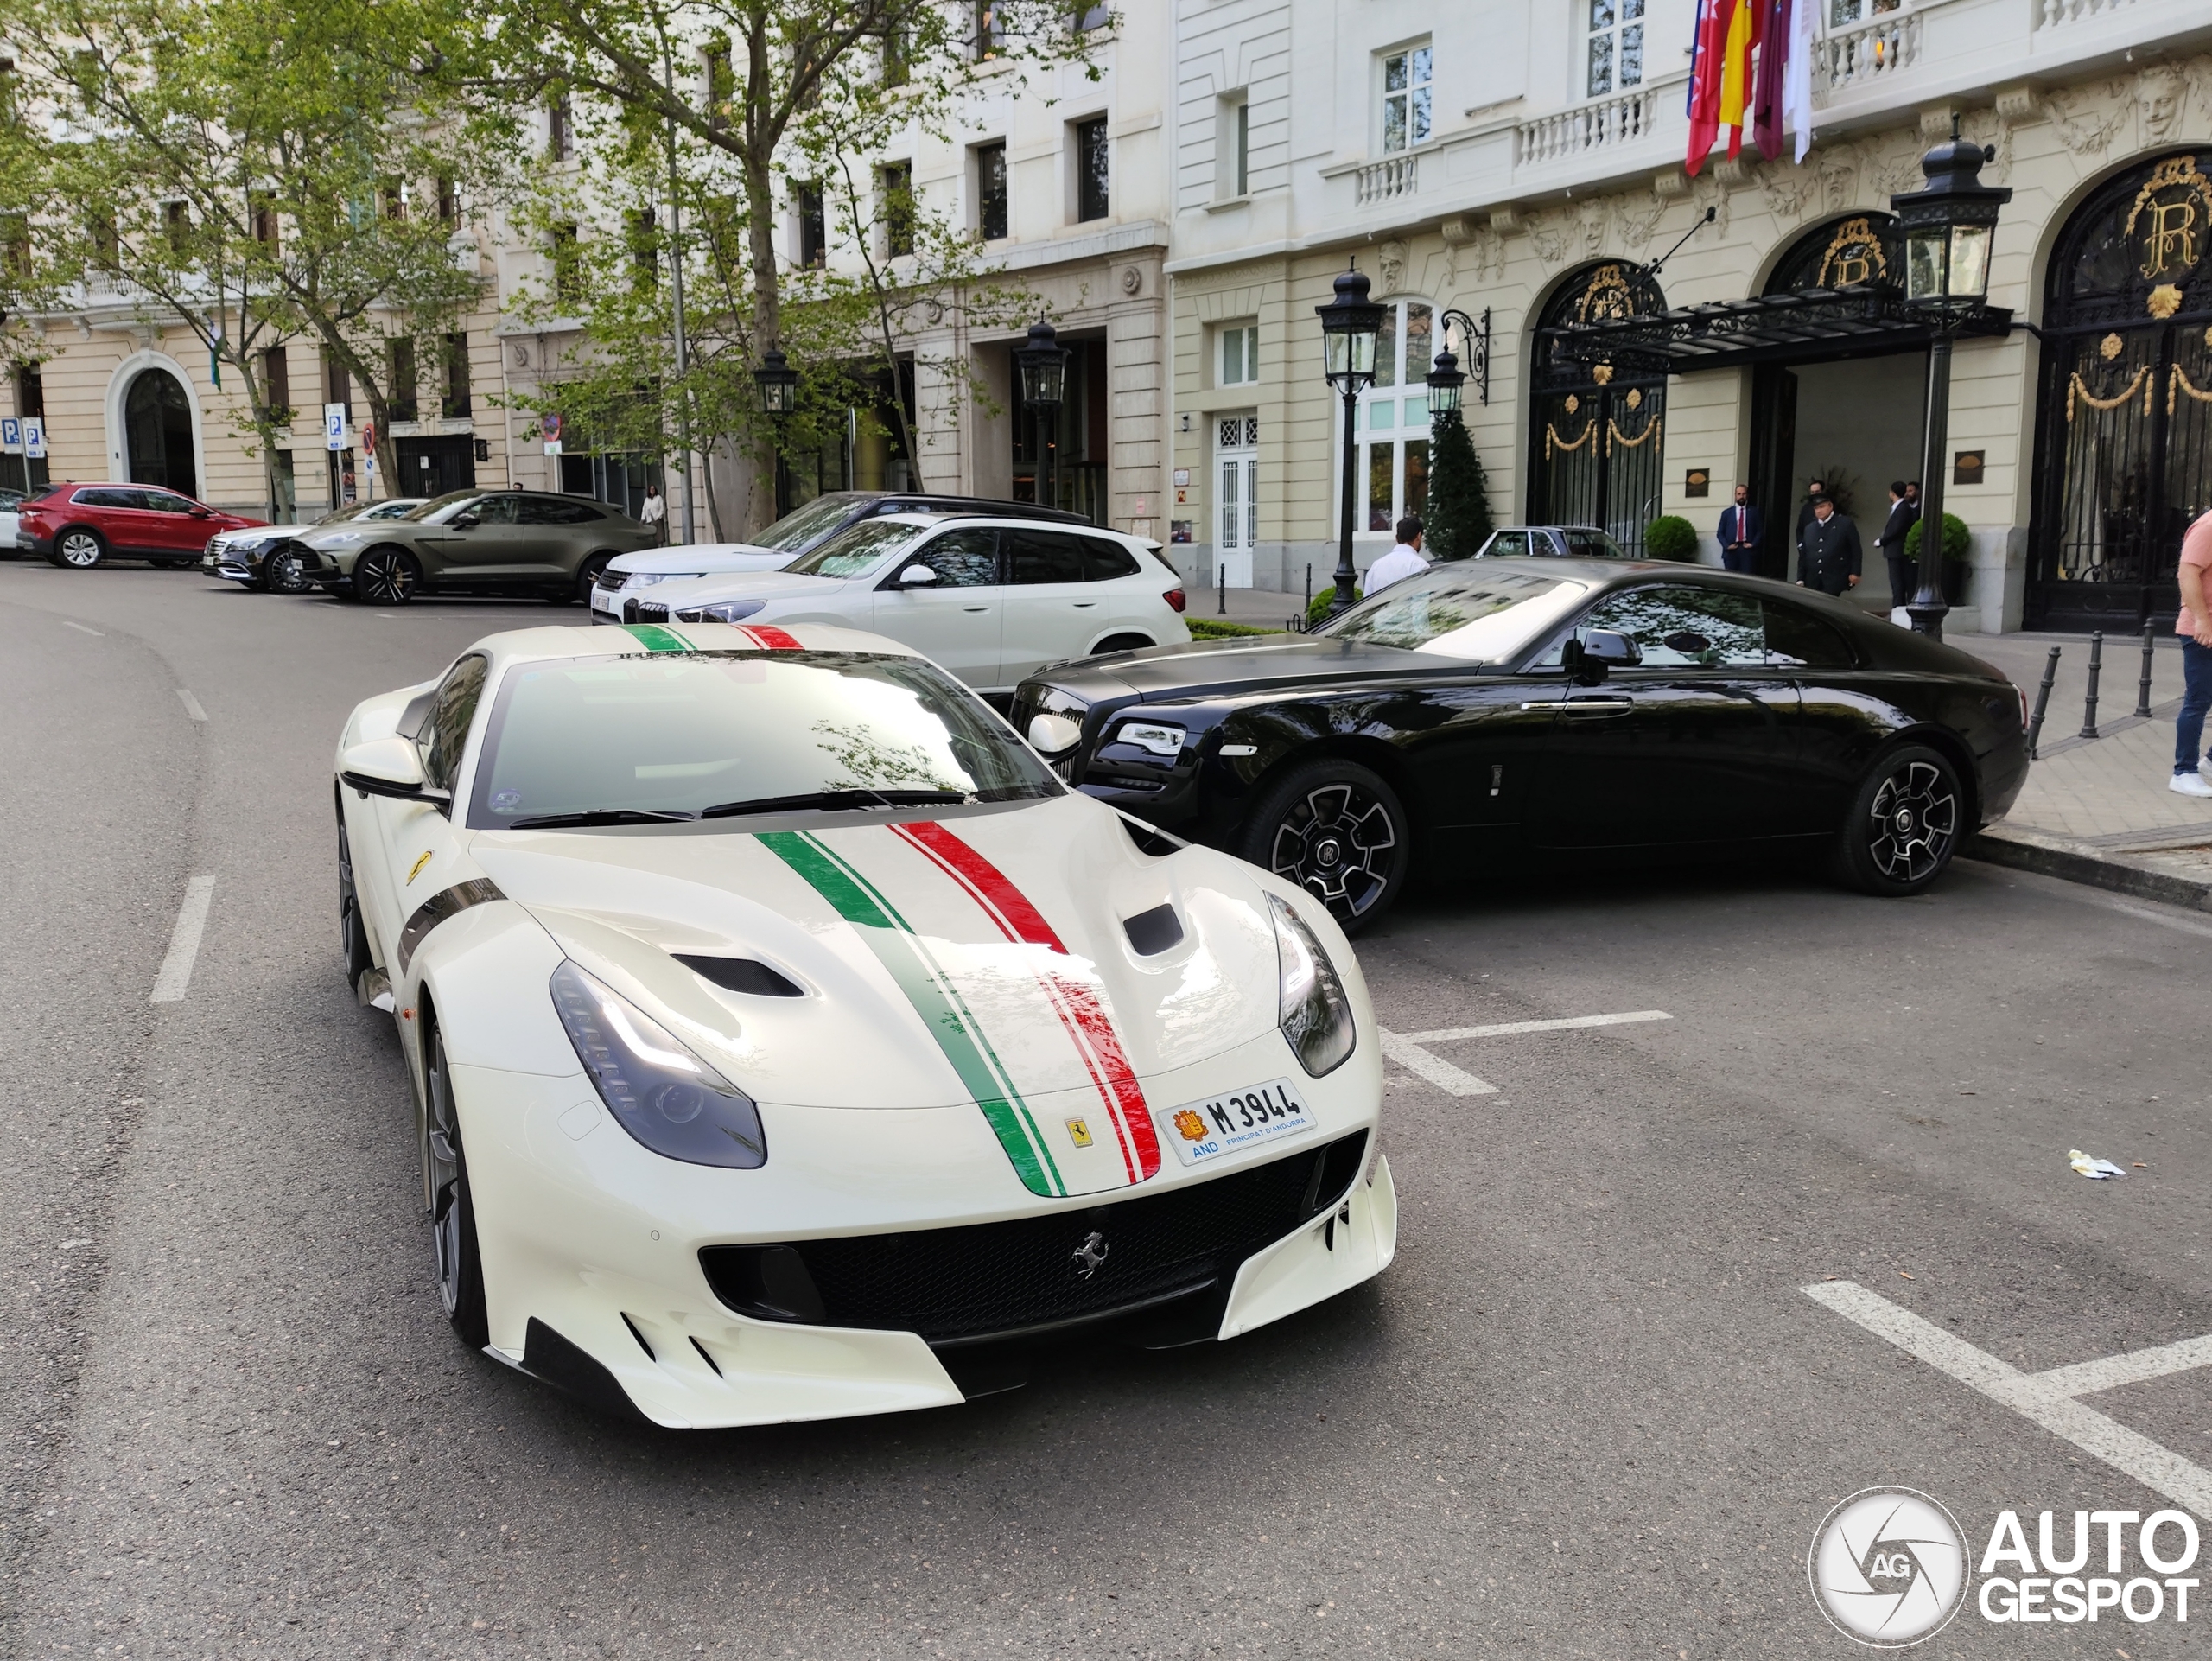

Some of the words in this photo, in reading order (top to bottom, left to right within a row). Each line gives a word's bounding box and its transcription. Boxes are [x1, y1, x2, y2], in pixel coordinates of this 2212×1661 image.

[4, 421, 16, 442] P
[331, 417, 339, 435] P
[28, 429, 36, 443] P
[1206, 1102, 1236, 1135] M
[1230, 1085, 1300, 1128] 3944
[1226, 1130, 1265, 1146] PRINCIPAT
[1265, 1117, 1306, 1135] D'ANDORRA
[1192, 1142, 1219, 1158] AND
